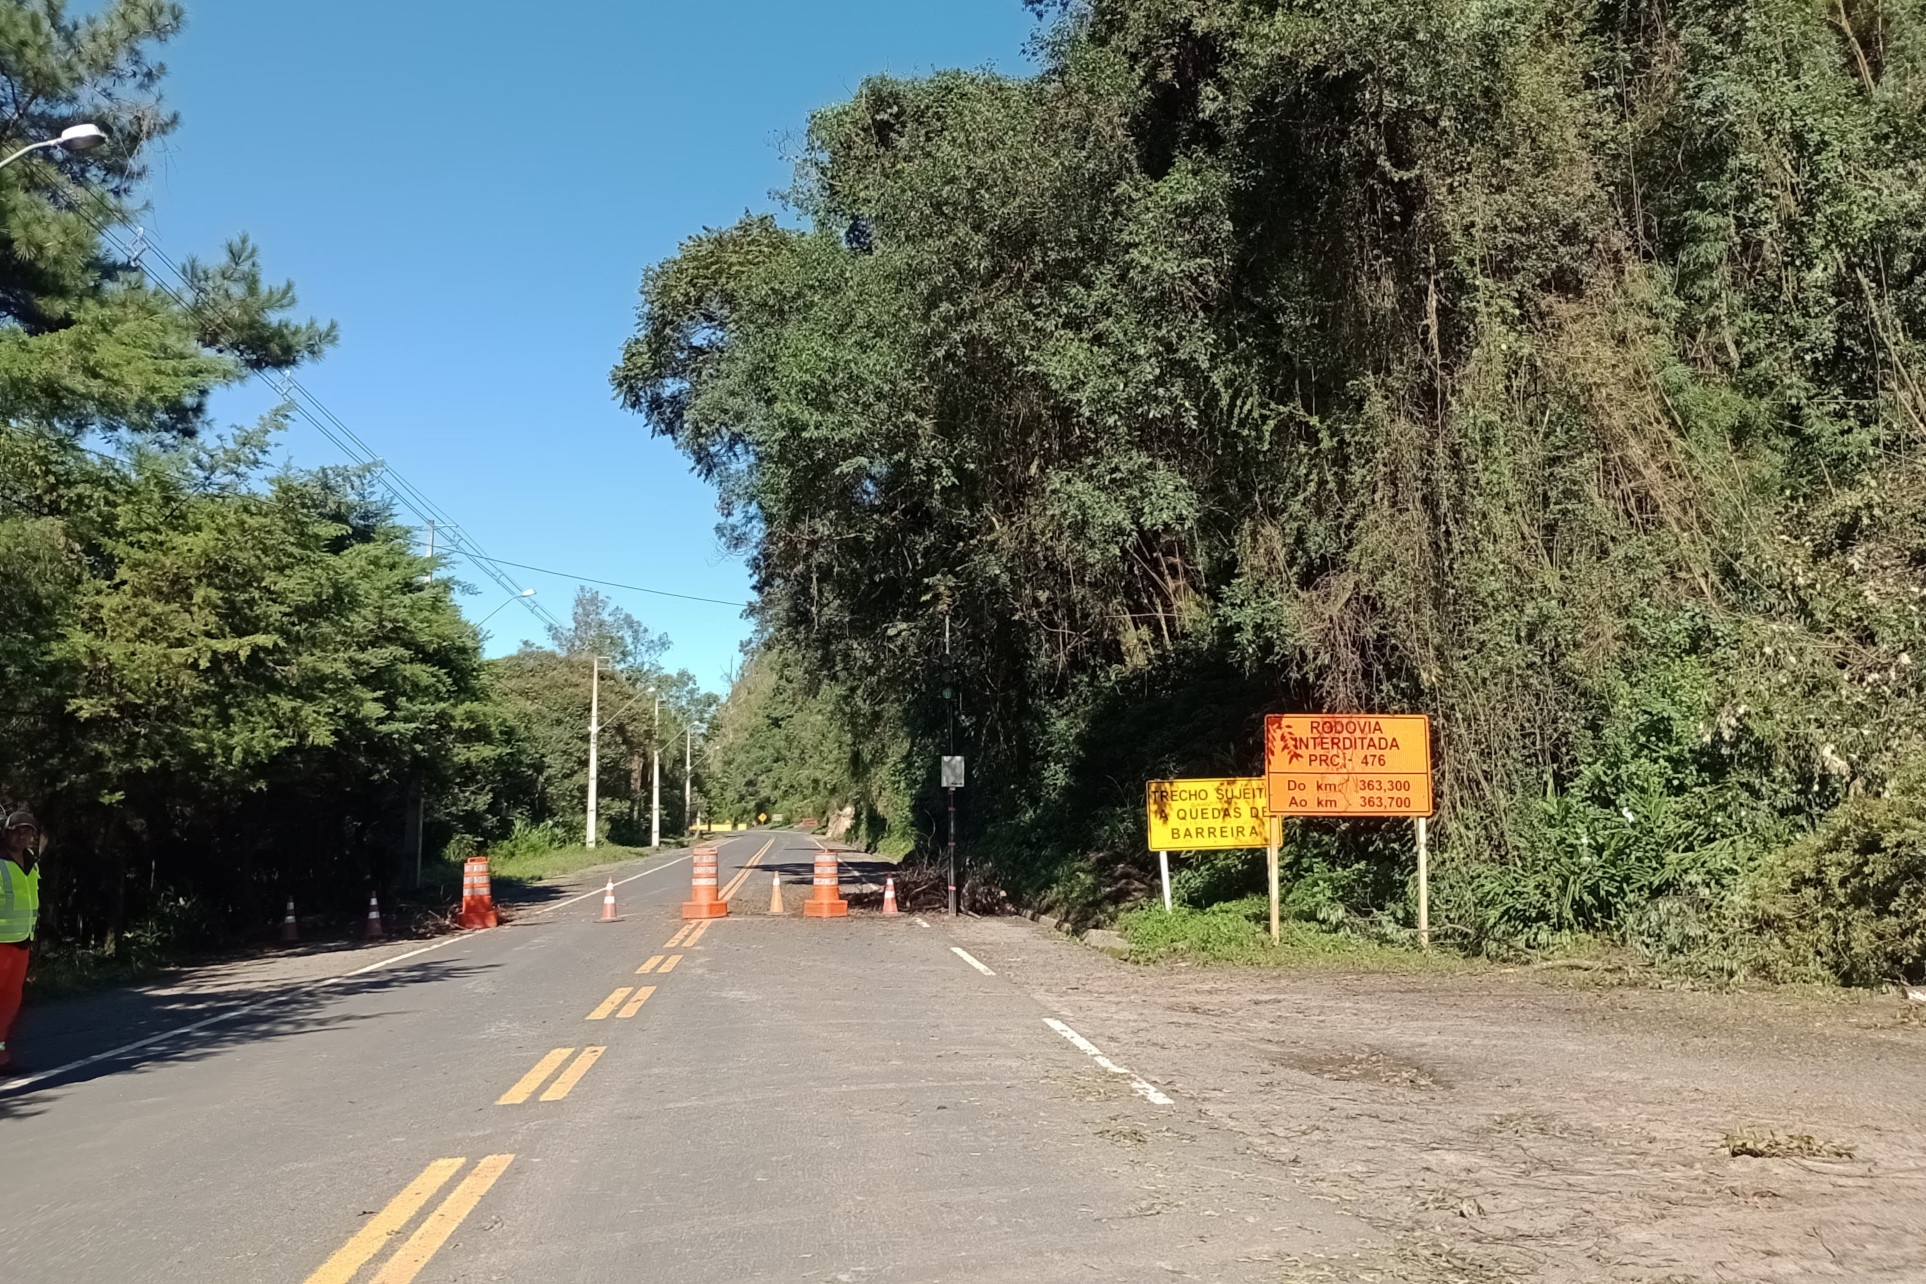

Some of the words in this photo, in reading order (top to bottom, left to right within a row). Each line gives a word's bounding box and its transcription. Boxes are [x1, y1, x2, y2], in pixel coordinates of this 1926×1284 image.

[1310, 720, 1384, 734] RODOVIA
[1295, 737, 1400, 750] INTERDITADA
[1308, 754, 1340, 767] PRC
[1361, 754, 1386, 767] 476
[1287, 779, 1306, 791] Do
[1316, 779, 1337, 791] km
[1359, 780, 1411, 793] 363,300
[1151, 789, 1209, 802] TRECHO
[1216, 787, 1267, 800] SUJEIT
[1288, 796, 1308, 808] Ao
[1316, 796, 1337, 808] km
[1359, 796, 1411, 809] 363,700
[1160, 808, 1169, 821] A
[1176, 807, 1242, 821] QUEDAS
[1171, 825, 1259, 840] BARREIRA
